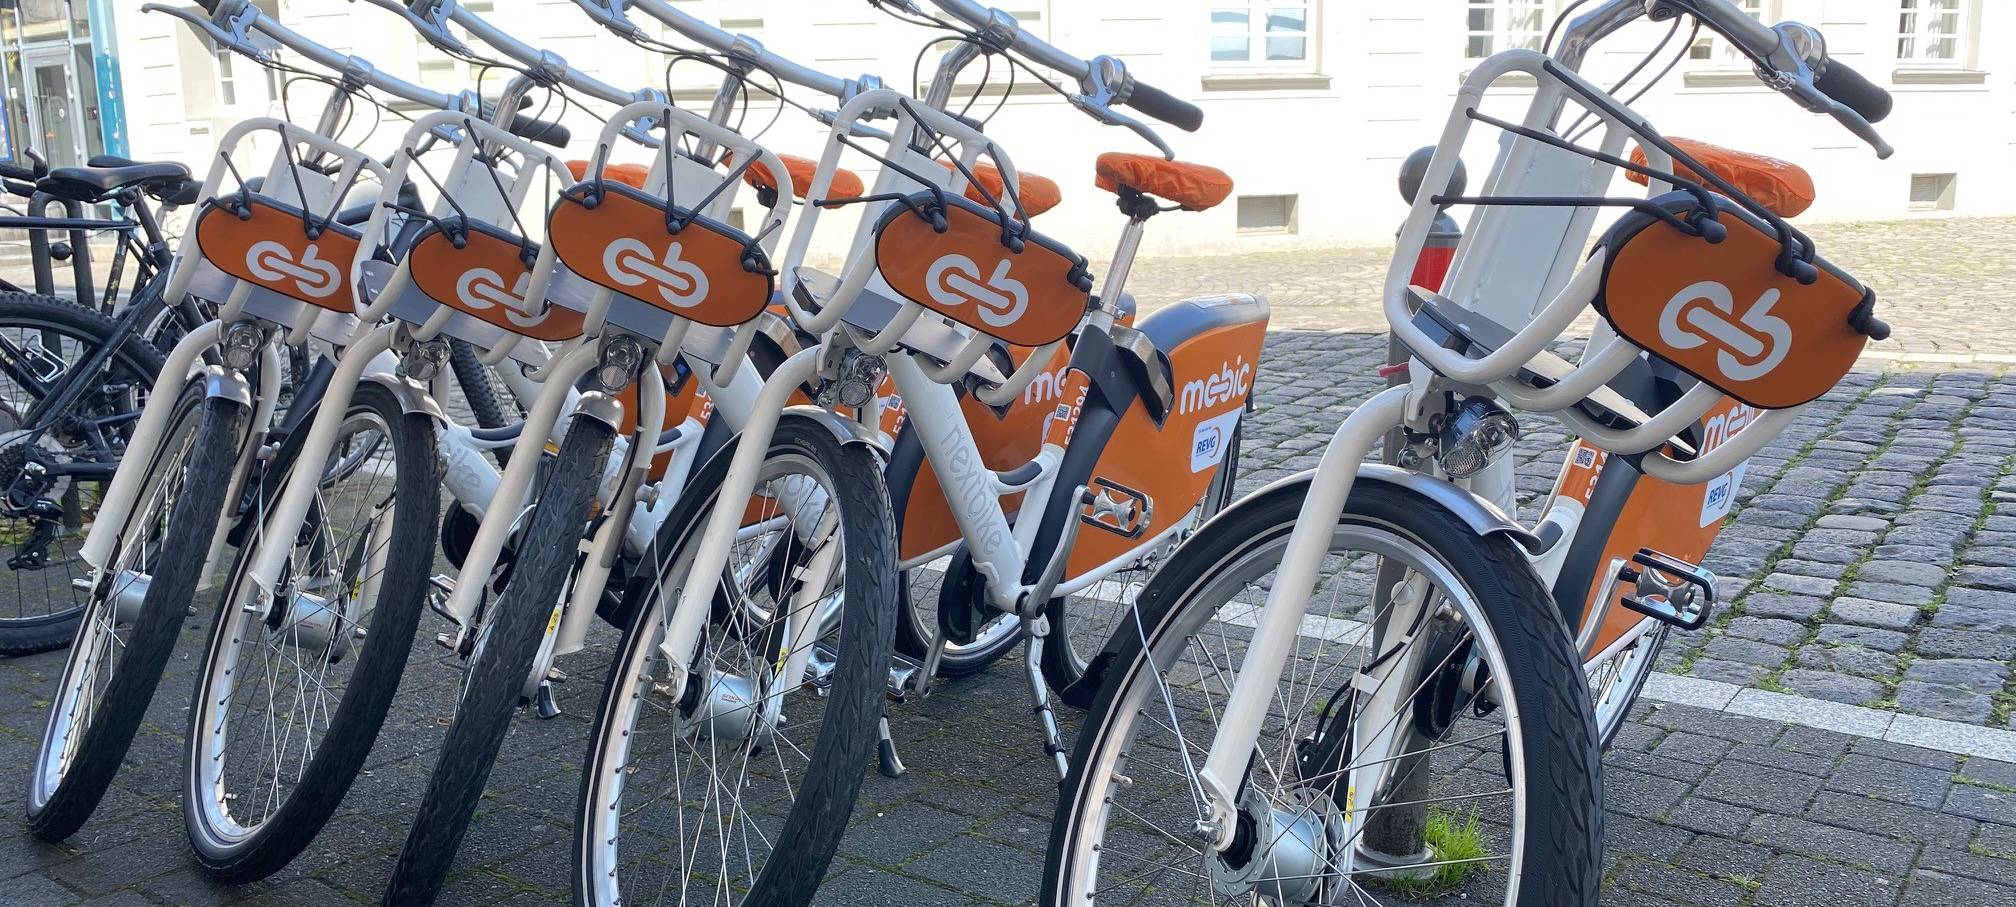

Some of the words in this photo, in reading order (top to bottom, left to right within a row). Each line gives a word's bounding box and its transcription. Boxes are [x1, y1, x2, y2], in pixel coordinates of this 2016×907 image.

[1180, 354, 1250, 415] mobic
[1196, 436, 1216, 453] REVG
[941, 424, 1002, 555] nextbike
[1707, 483, 1728, 504] REVG
